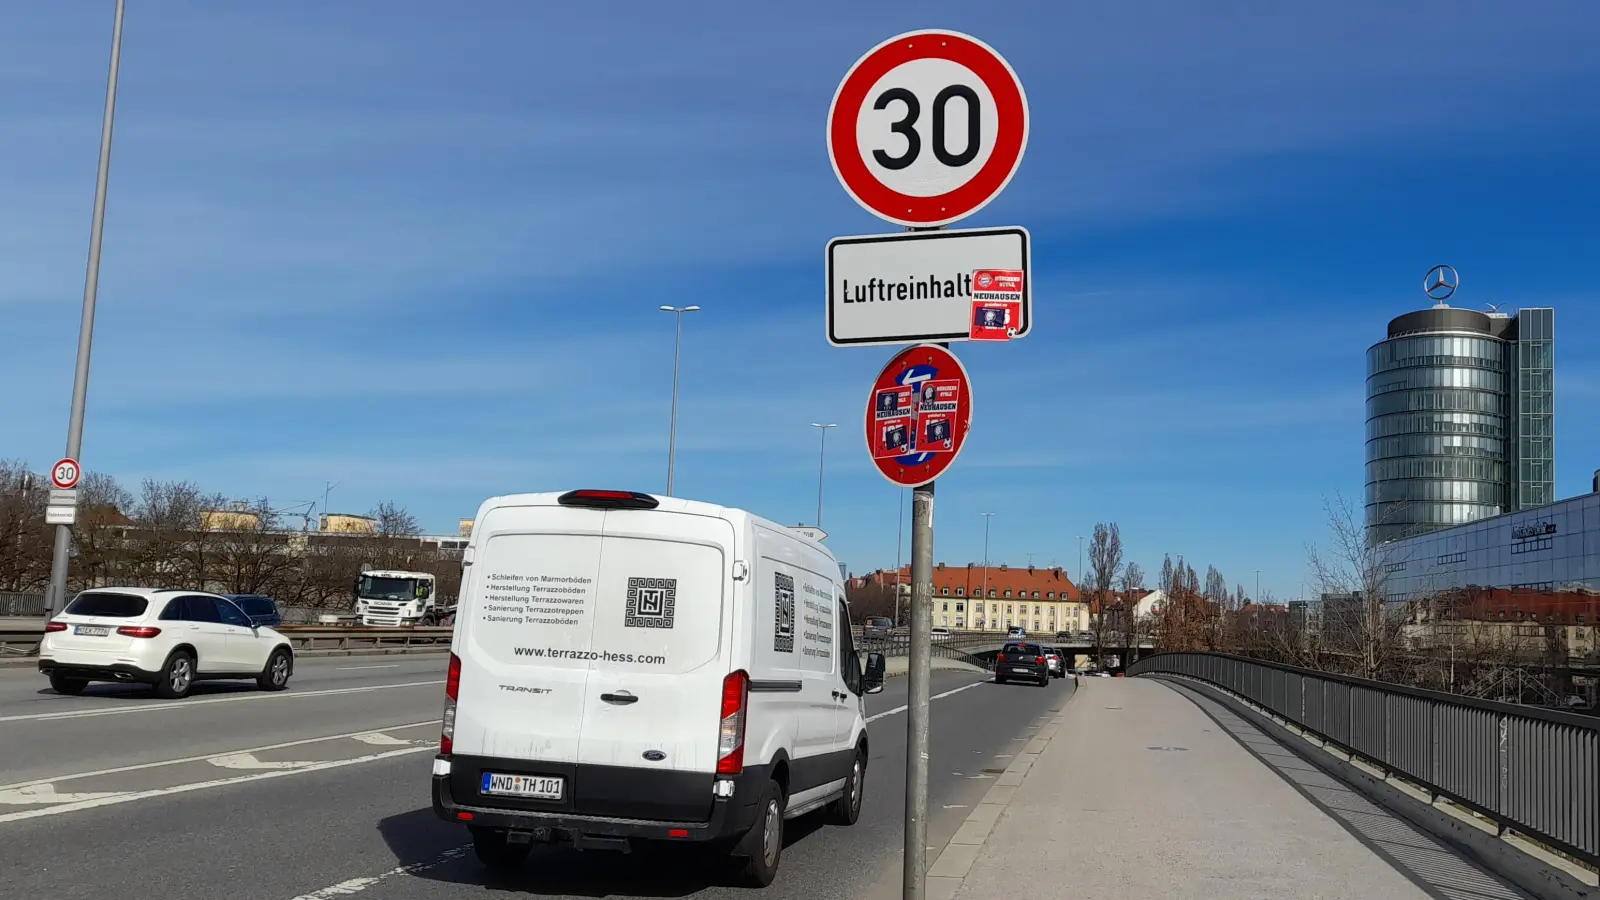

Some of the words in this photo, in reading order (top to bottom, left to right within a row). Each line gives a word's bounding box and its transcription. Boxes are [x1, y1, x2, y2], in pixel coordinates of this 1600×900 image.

[872, 84, 981, 171] 30
[973, 292, 1021, 301] NEUHAUSEN
[919, 402, 957, 411] NEUHAUSEN
[876, 407, 911, 419] NEUHAUSEN
[57, 466, 75, 480] 30
[491, 573, 524, 581] Schleifen
[525, 574, 539, 582] von
[540, 575, 592, 584] Marmorböden
[490, 584, 531, 593] Herstellung
[532, 585, 586, 594] Terrazzoböden
[489, 594, 530, 604] Herstellung
[531, 595, 584, 605] Terrazzowaren
[488, 604, 524, 614] Sanierung
[525, 605, 584, 615] Terrazzotreppen
[487, 614, 523, 624] Sanierung
[525, 615, 579, 625] Terrazzoböden
[513, 646, 666, 665] www.terrazzo-hess.com
[498, 684, 553, 695] TRANSIT
[490, 775, 514, 791] WND
[522, 777, 537, 792] TH
[538, 779, 560, 794] 101
